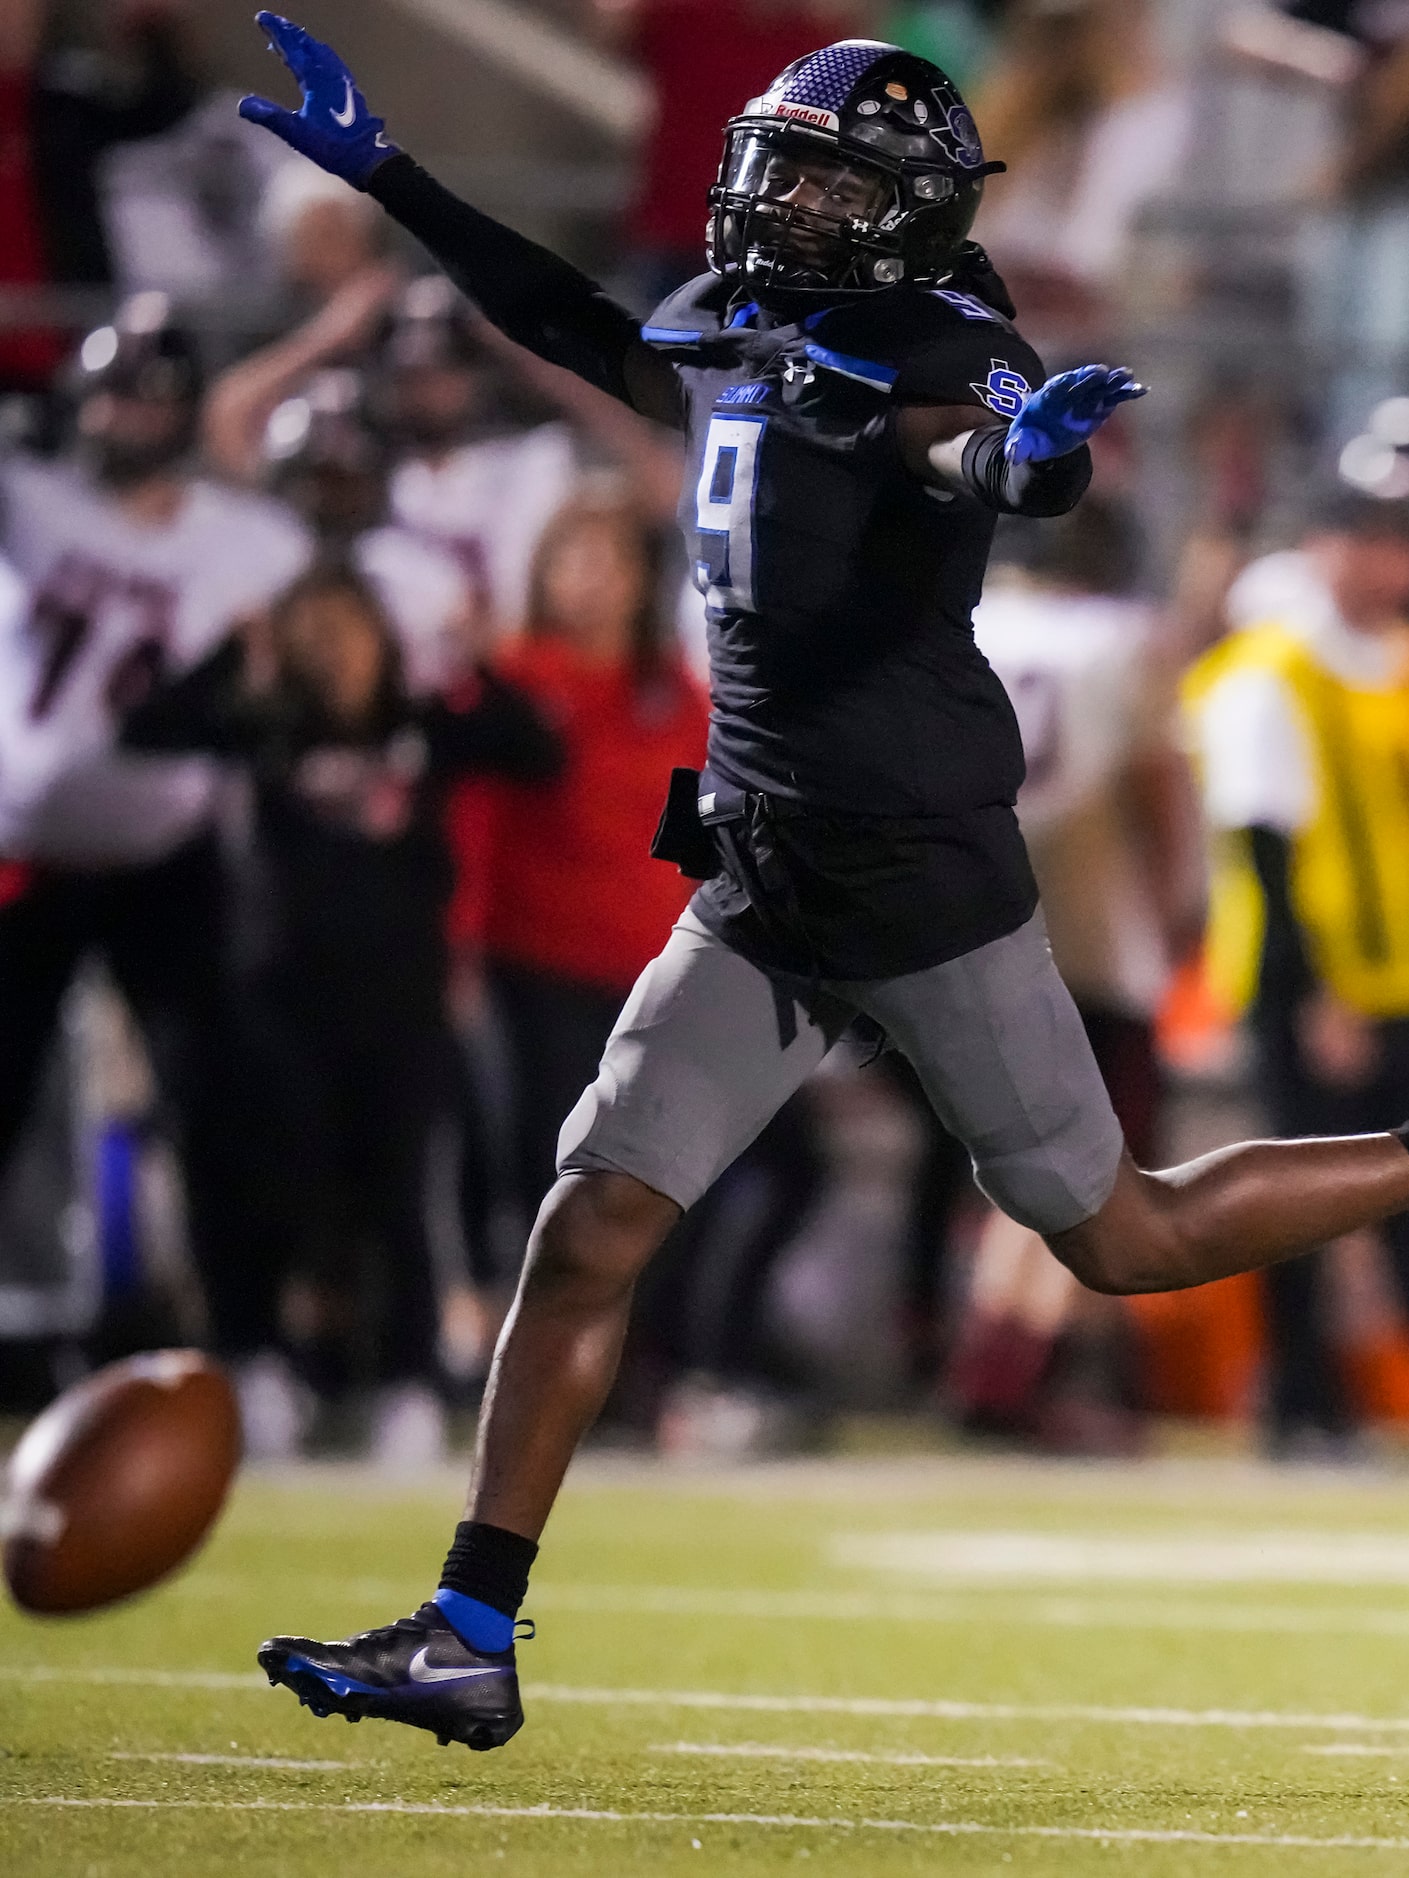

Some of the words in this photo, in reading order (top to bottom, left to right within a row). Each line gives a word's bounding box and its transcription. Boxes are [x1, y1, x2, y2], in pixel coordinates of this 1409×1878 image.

[775, 104, 831, 127] Riddell
[715, 384, 771, 404] SUMMIT
[985, 367, 1029, 419] S
[695, 411, 768, 613] 9
